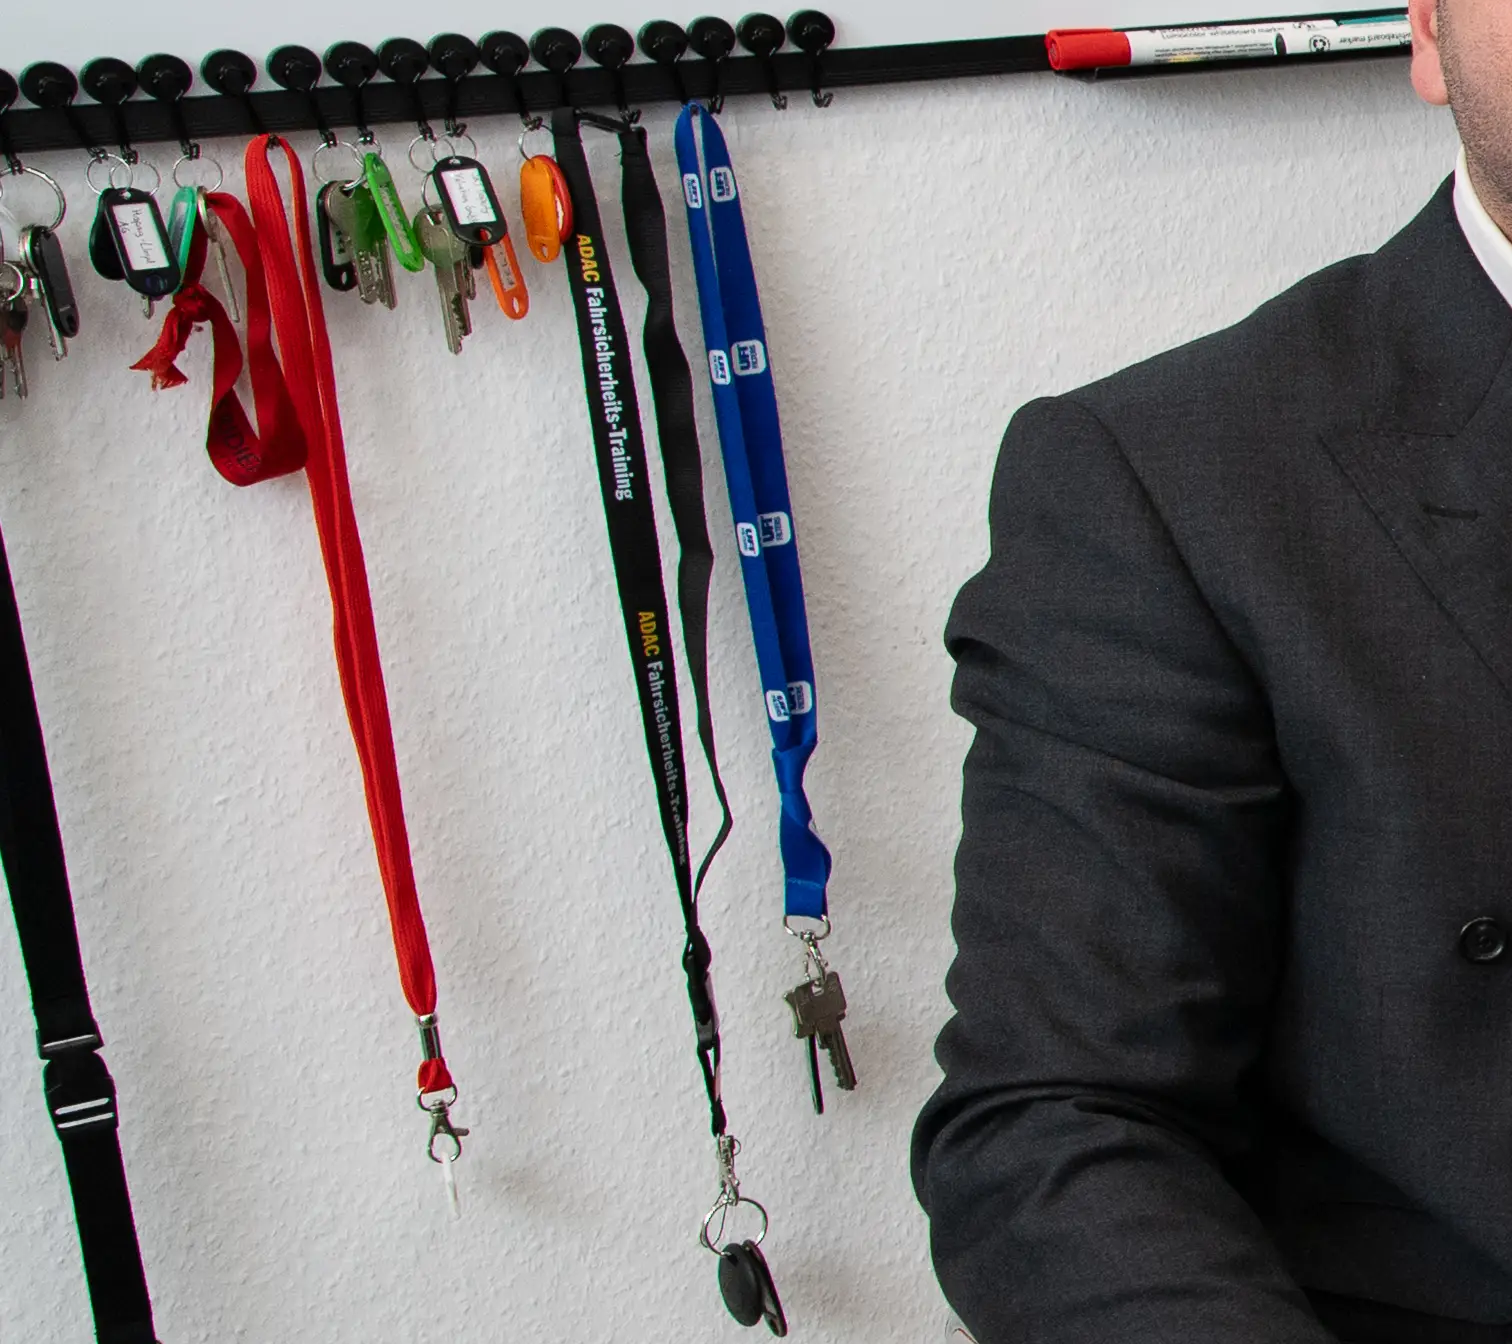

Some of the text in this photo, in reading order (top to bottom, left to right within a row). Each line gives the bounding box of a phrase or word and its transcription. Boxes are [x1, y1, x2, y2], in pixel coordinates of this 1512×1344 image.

[576, 234, 634, 501] ADAC Fahrsicherheits-Training
[638, 610, 660, 657] ADAC
